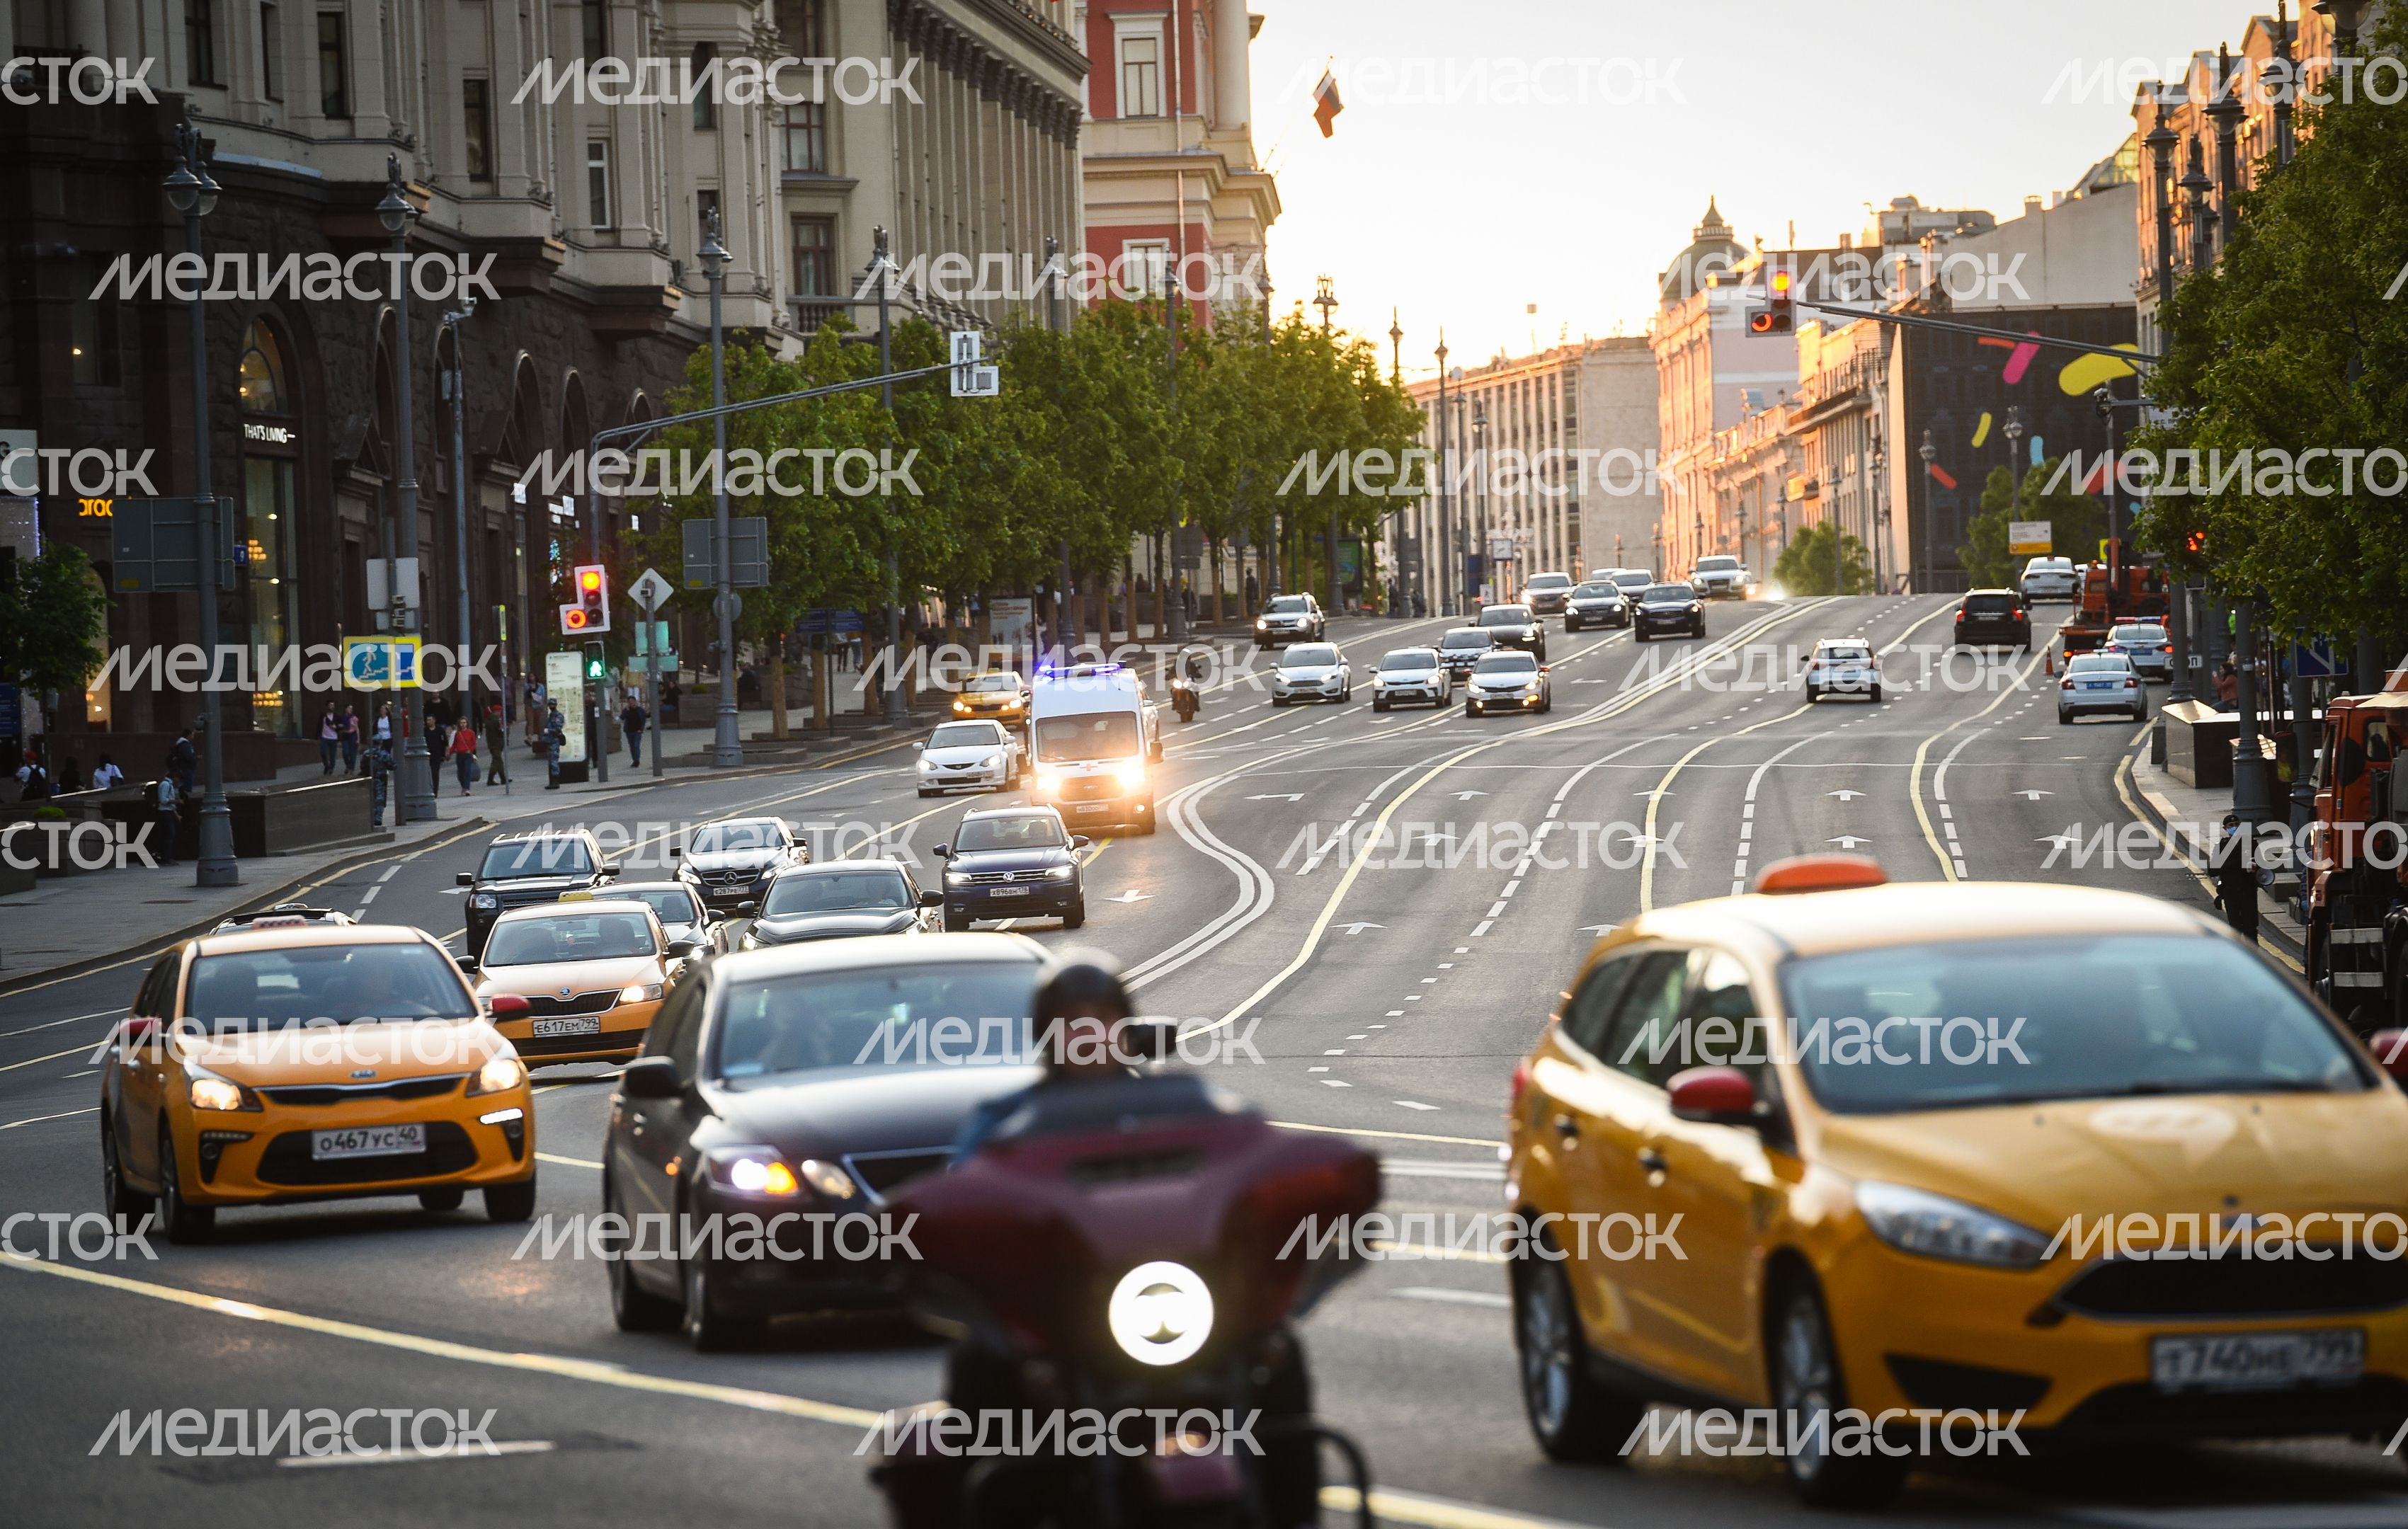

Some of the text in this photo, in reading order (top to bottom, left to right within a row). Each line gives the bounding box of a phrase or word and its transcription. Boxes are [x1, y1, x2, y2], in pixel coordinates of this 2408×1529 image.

[537, 1018, 596, 1033] Е617ЕМ 799
[399, 1126, 418, 1140] 40
